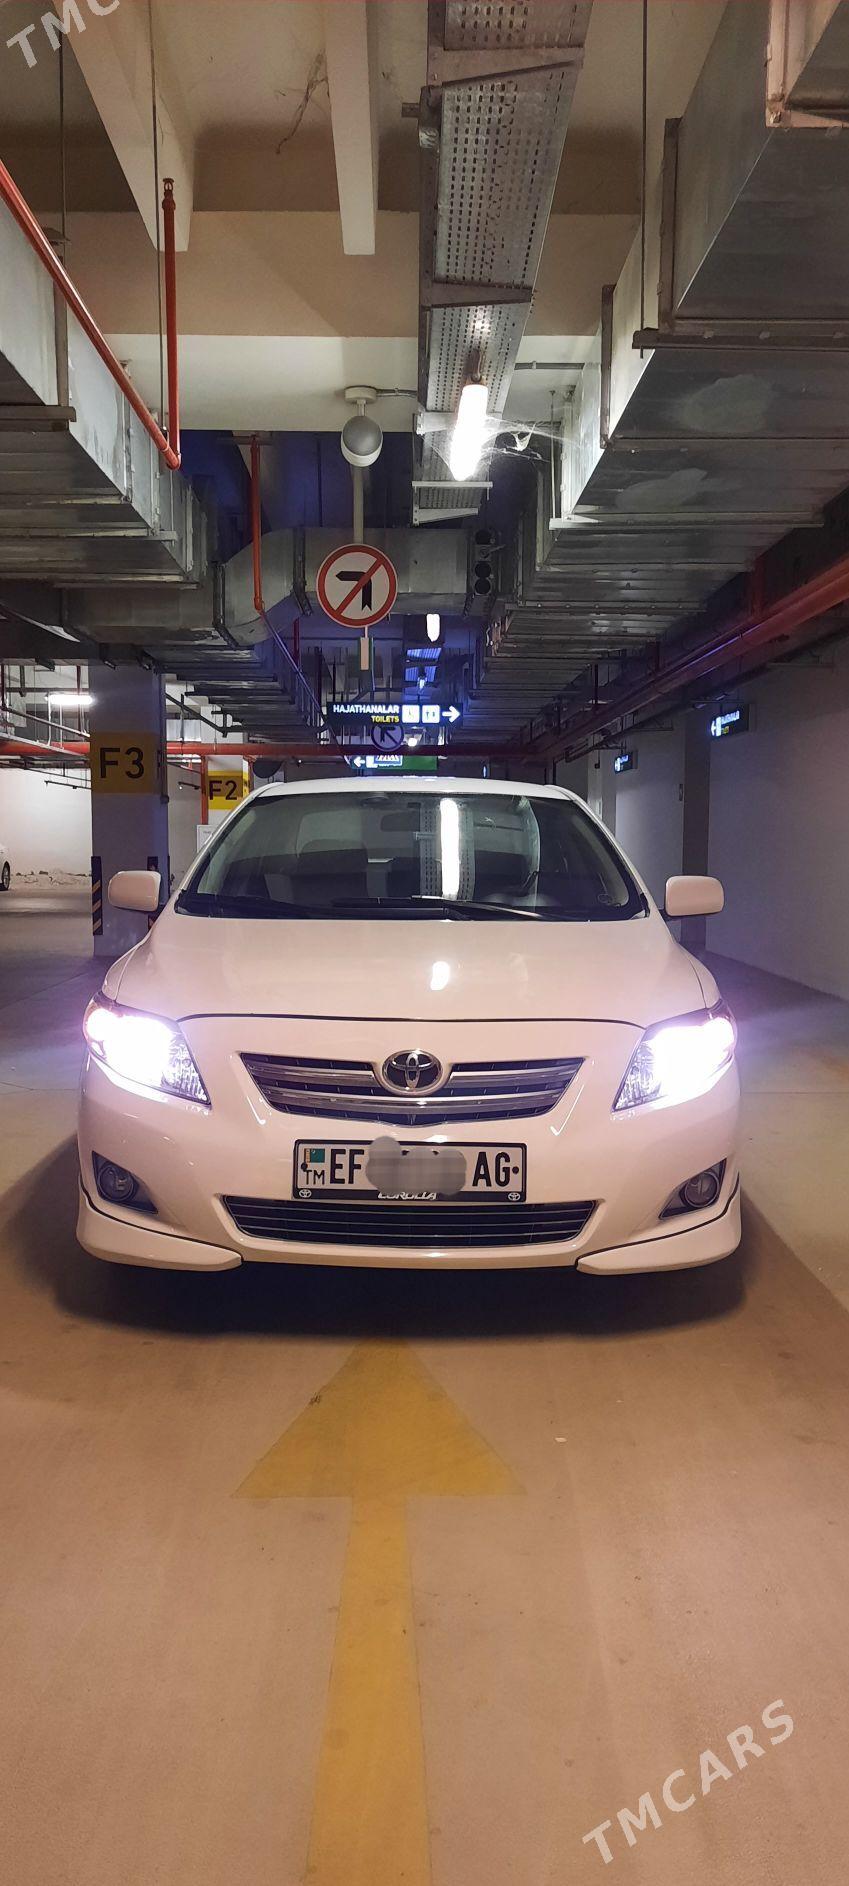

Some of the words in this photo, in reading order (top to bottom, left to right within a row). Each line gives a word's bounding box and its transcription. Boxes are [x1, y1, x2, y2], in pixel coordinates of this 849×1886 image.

[333, 704, 400, 714] HAJATHANALAR
[371, 715, 400, 723] TOILETS
[100, 747, 145, 779] F3
[208, 780, 238, 801] F2
[329, 1148, 365, 1185] EF
[472, 1151, 511, 1187] AG
[305, 1169, 326, 1185] TM
